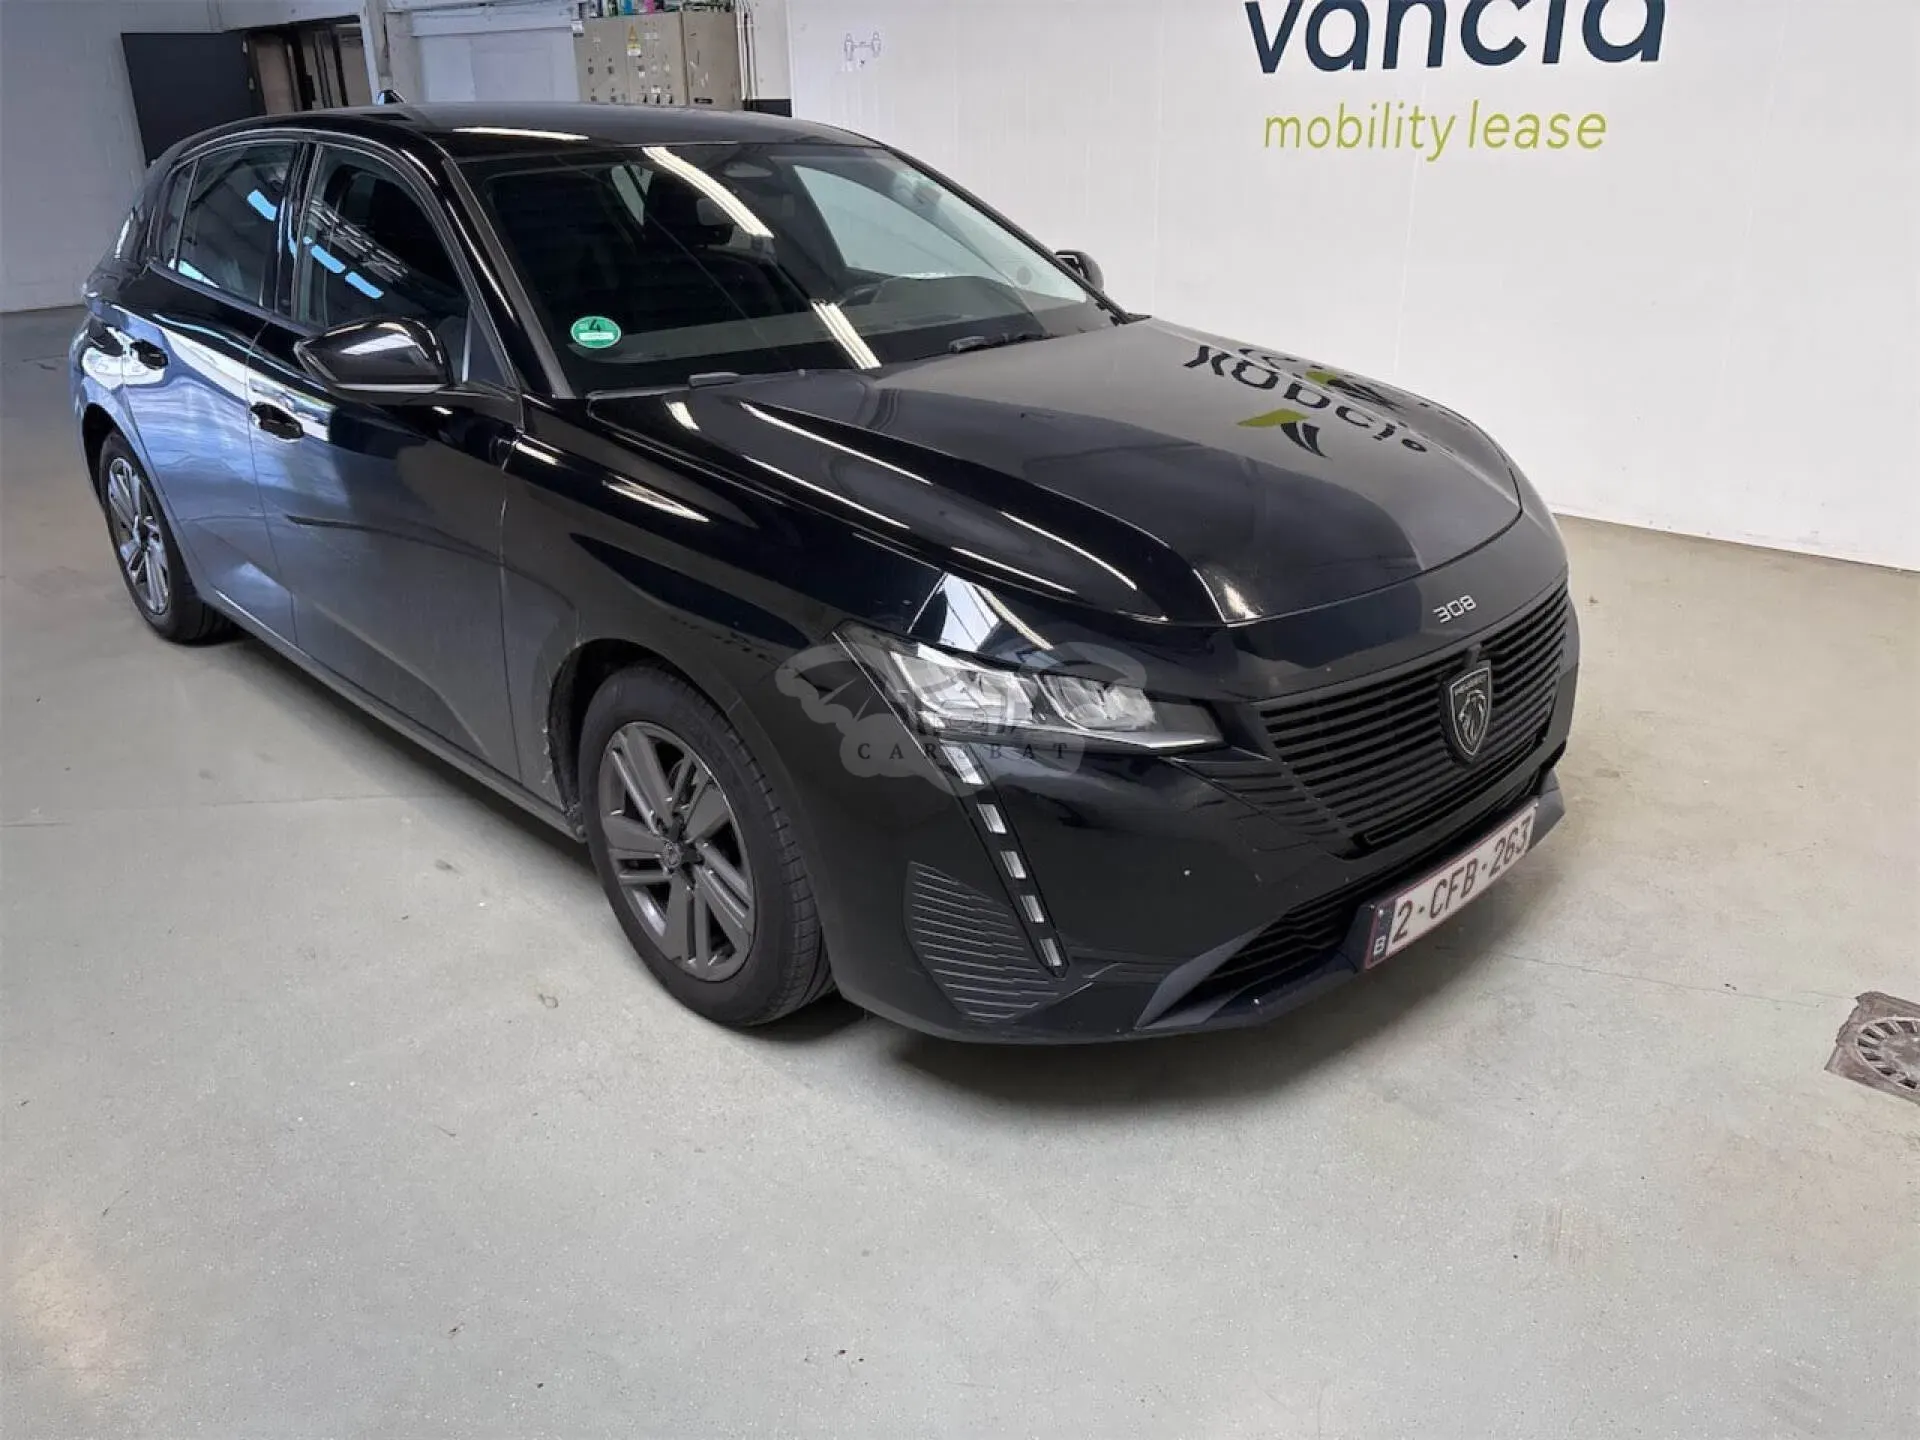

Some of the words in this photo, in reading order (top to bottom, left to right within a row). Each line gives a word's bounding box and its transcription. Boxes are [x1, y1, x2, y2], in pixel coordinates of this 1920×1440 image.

[1264, 101, 1457, 162] mobility
[1468, 100, 1608, 150] lease
[1432, 594, 1477, 624] 308
[1391, 815, 1532, 944] 2-CFB-263
